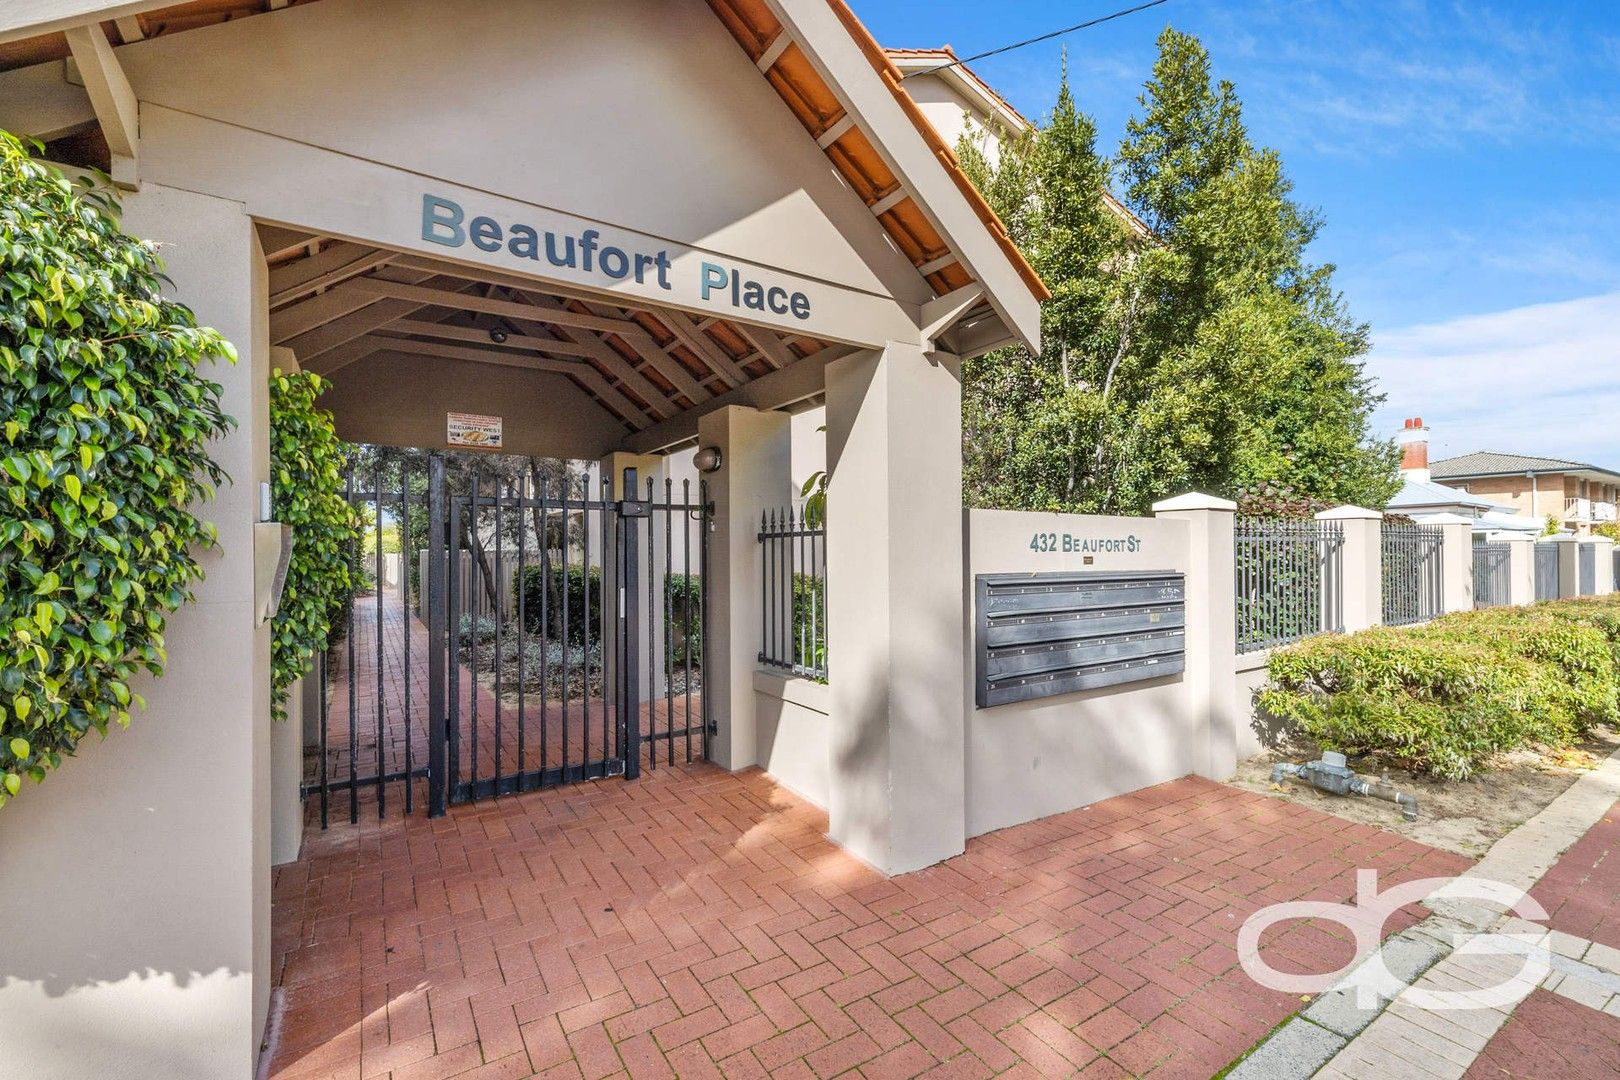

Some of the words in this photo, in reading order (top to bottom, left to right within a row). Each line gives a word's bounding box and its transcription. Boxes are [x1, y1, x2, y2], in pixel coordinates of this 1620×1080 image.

[421, 193, 672, 291] Beaufort
[701, 261, 811, 320] Place
[1030, 533, 1057, 553] 432
